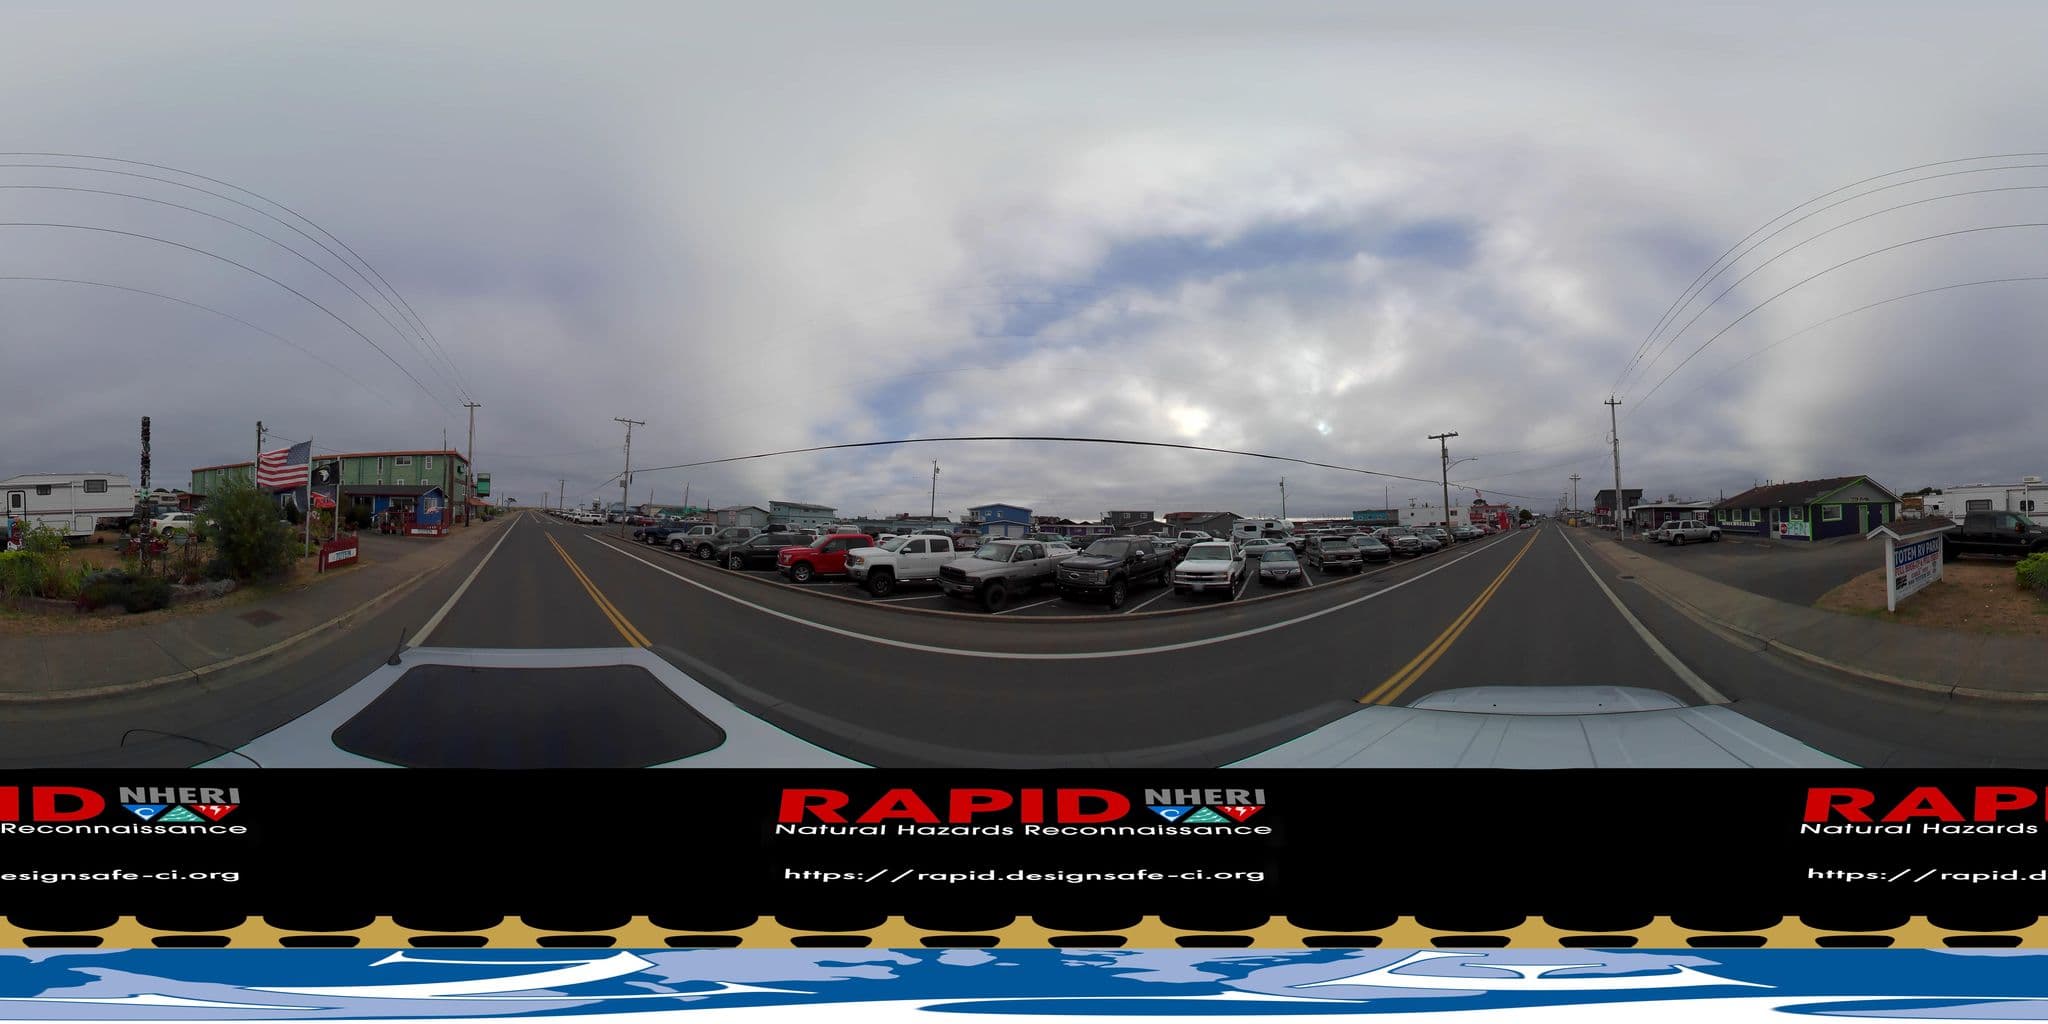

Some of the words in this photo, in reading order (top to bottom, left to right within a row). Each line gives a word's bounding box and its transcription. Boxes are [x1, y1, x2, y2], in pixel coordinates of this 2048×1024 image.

[1895, 544, 1917, 567] TOTEM
[1917, 543, 1926, 557] RV
[1926, 540, 1939, 554] PARK
